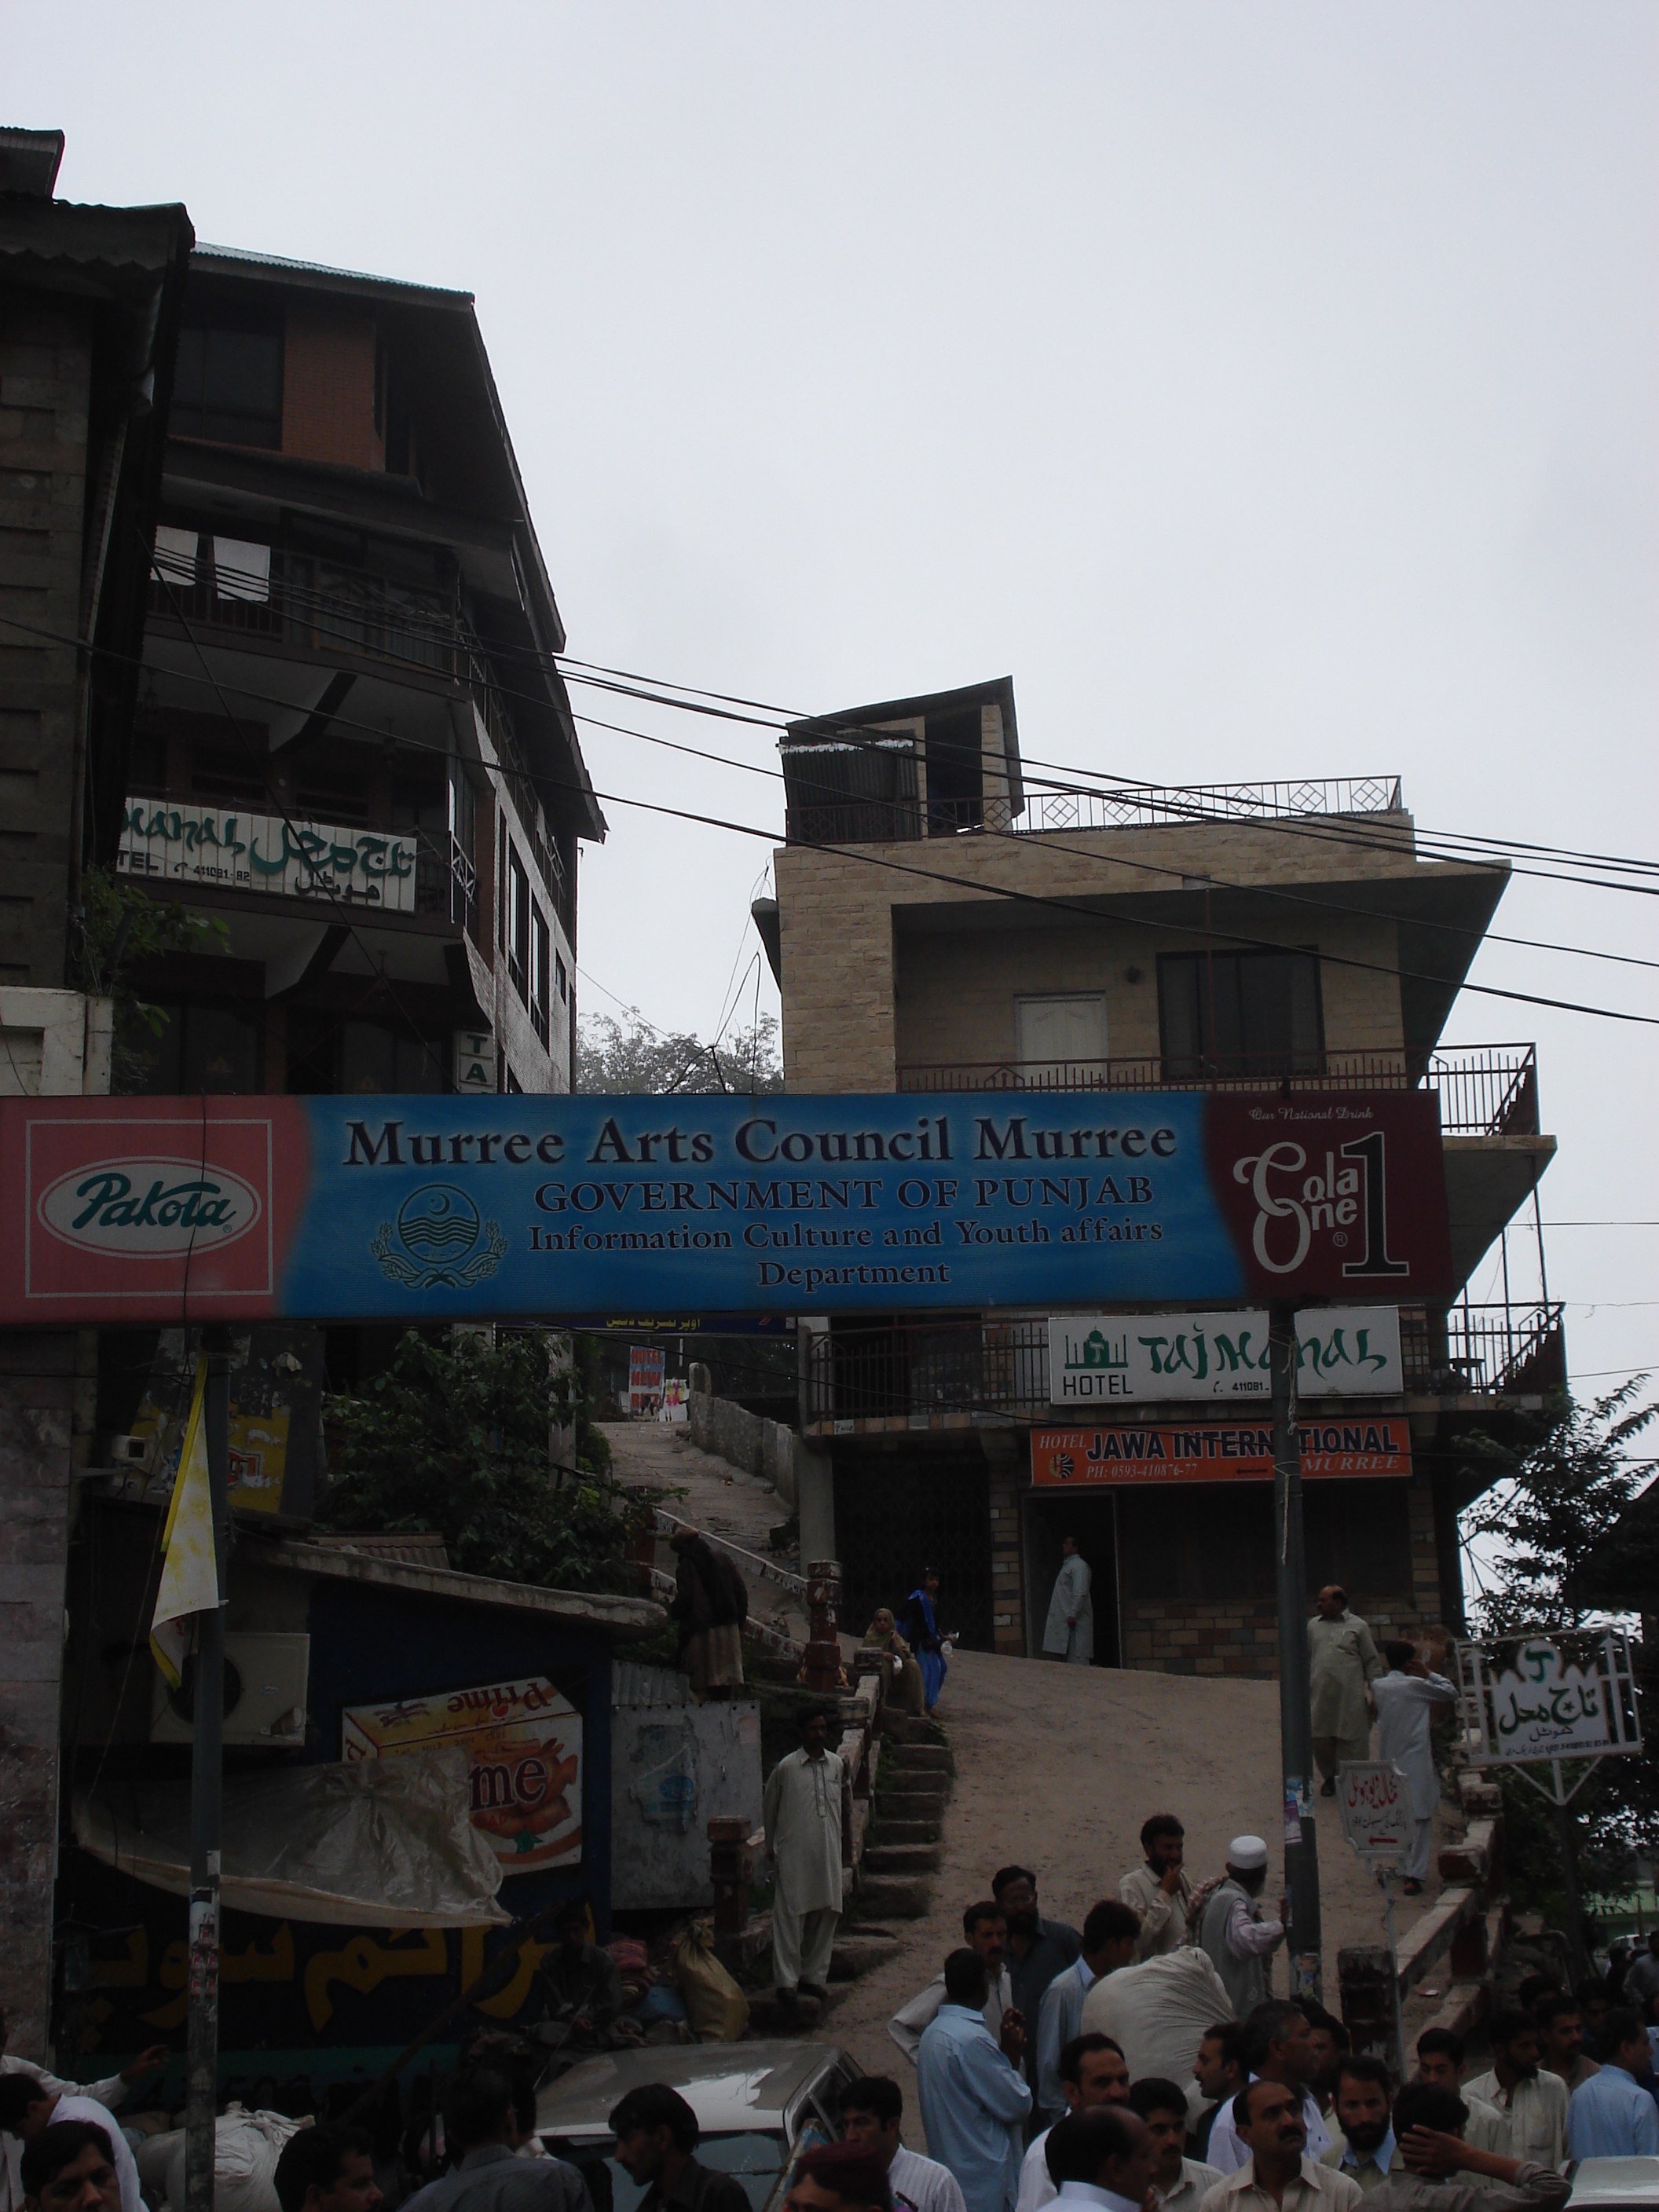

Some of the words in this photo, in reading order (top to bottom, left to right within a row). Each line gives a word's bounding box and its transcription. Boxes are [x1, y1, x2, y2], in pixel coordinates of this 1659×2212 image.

[119, 849, 159, 870] TEL
[1278, 1107, 1333, 1120] National
[1336, 1106, 1374, 1119] Drink
[343, 1120, 566, 1166] Murree
[587, 1117, 713, 1164] Arts
[734, 1117, 954, 1163] Council
[973, 1117, 1177, 1160] Murree
[1233, 1141, 1359, 1217] Cola
[535, 1180, 883, 1213] GOVERNMENT
[897, 1178, 958, 1209] OF
[975, 1175, 1154, 1211] PUNJAB
[529, 1225, 734, 1251] Information
[743, 1221, 873, 1249] Culture
[883, 1220, 943, 1245] and
[954, 1218, 1051, 1246] Youth
[1061, 1217, 1163, 1242] affairs
[758, 1262, 951, 1293] Department
[632, 1349, 661, 1364] HOTEL
[631, 1372, 661, 1386] NEW
[1063, 1375, 1133, 1396] HOTEL
[1039, 1434, 1087, 1449] HOTEL
[1086, 1432, 1166, 1461] JAWA
[1174, 1424, 1401, 1459] INTERNTIONAL
[1086, 1465, 1108, 1478] PH:
[1302, 1456, 1401, 1471] MURREE
